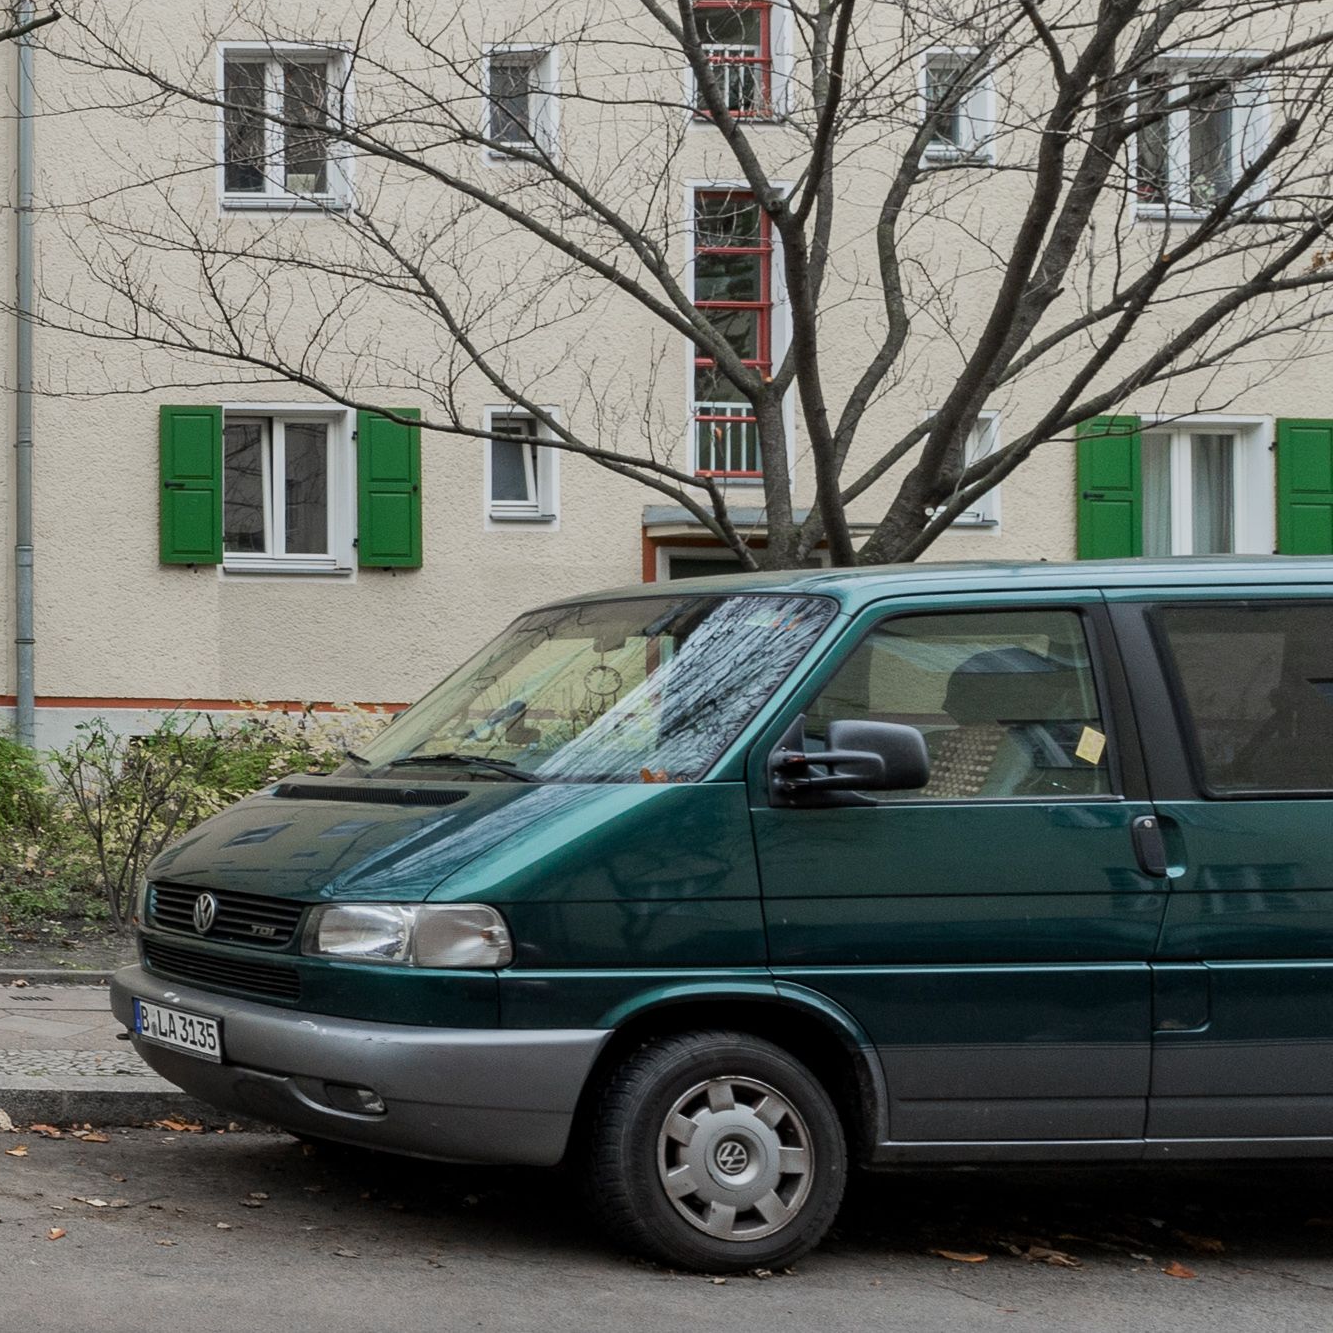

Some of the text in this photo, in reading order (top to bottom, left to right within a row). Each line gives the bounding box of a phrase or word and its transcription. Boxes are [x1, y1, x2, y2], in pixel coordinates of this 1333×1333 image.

[251, 924, 277, 937] TDI
[140, 1005, 217, 1051] B LA 3135
